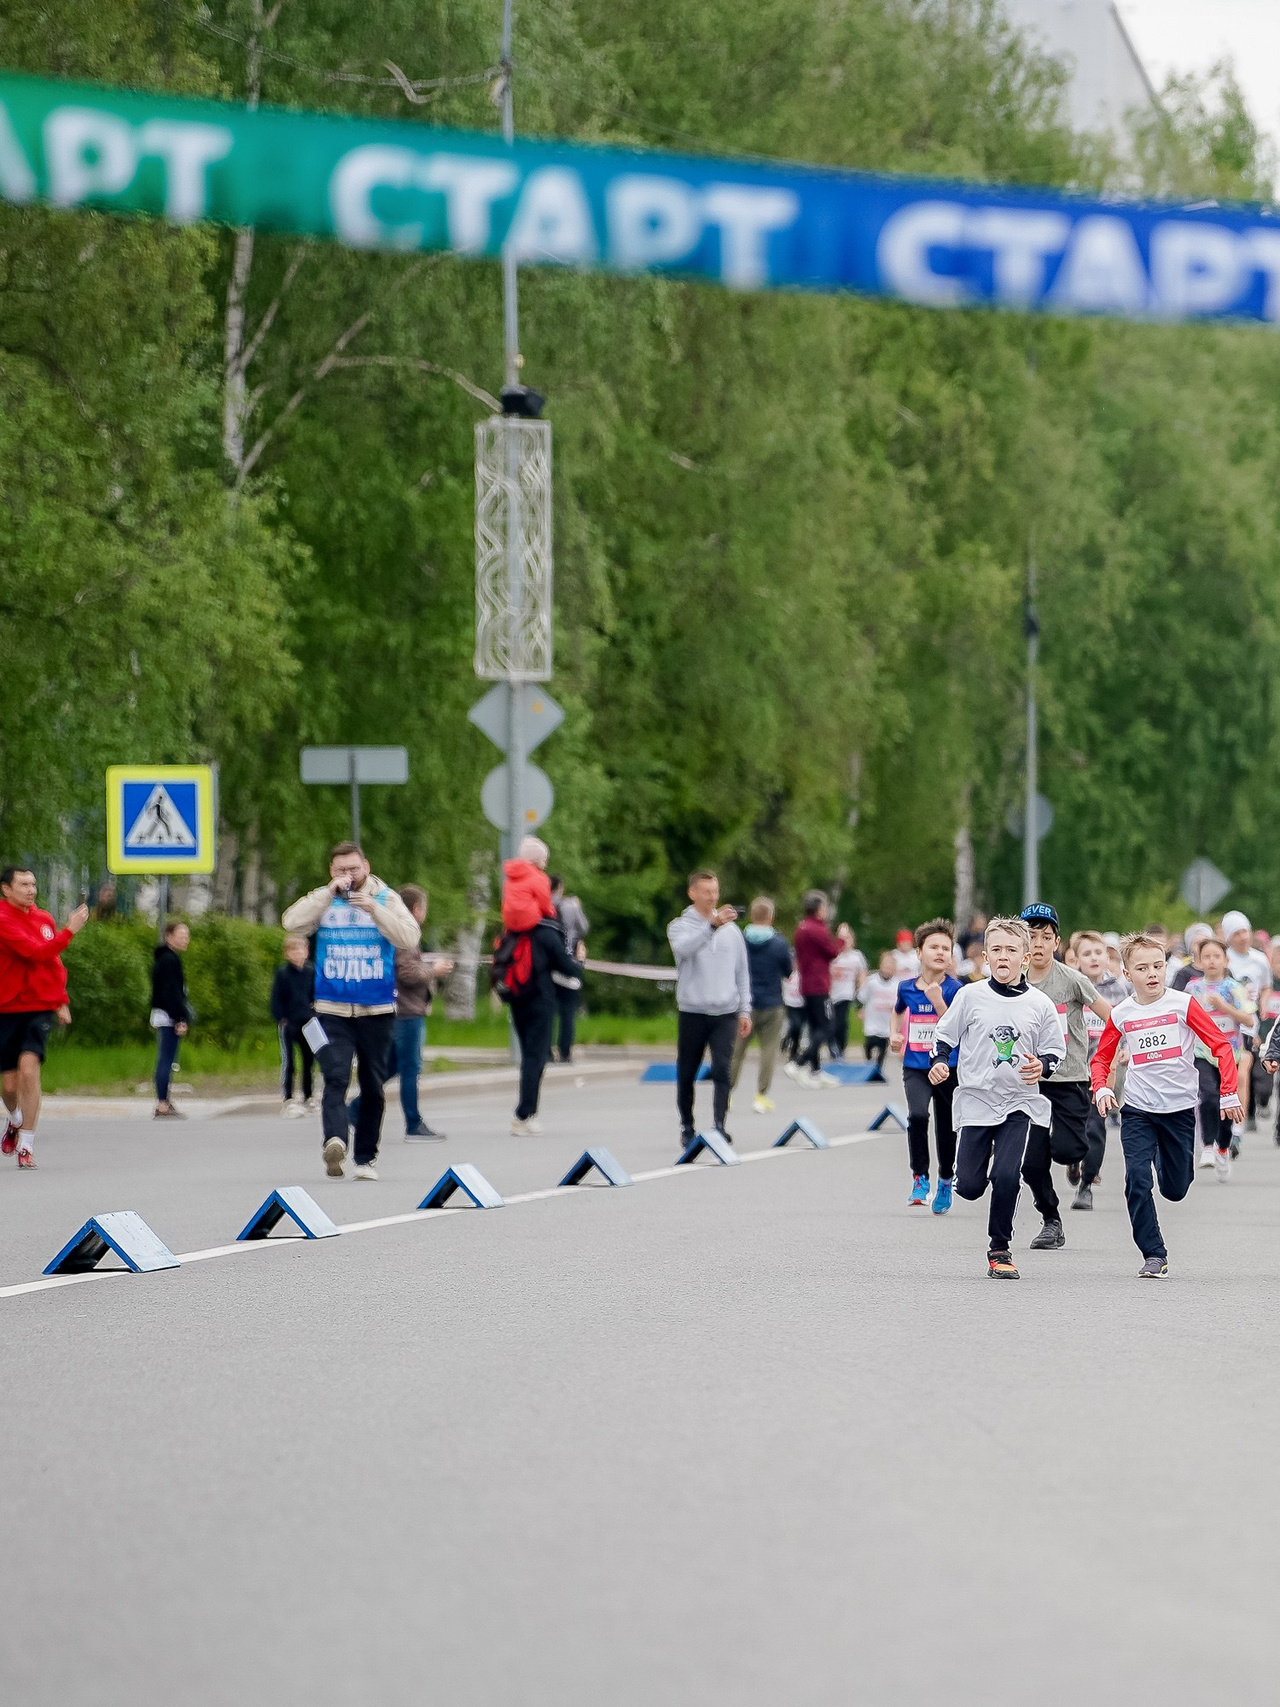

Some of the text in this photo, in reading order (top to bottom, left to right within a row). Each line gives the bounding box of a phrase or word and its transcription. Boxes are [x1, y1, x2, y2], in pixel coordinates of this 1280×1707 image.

[328, 142, 800, 290] СТАРТ
[1020, 905, 1052, 917] NEVER
[324, 958, 384, 982] СУДЬЯ
[1138, 1033, 1167, 1049] 2882
